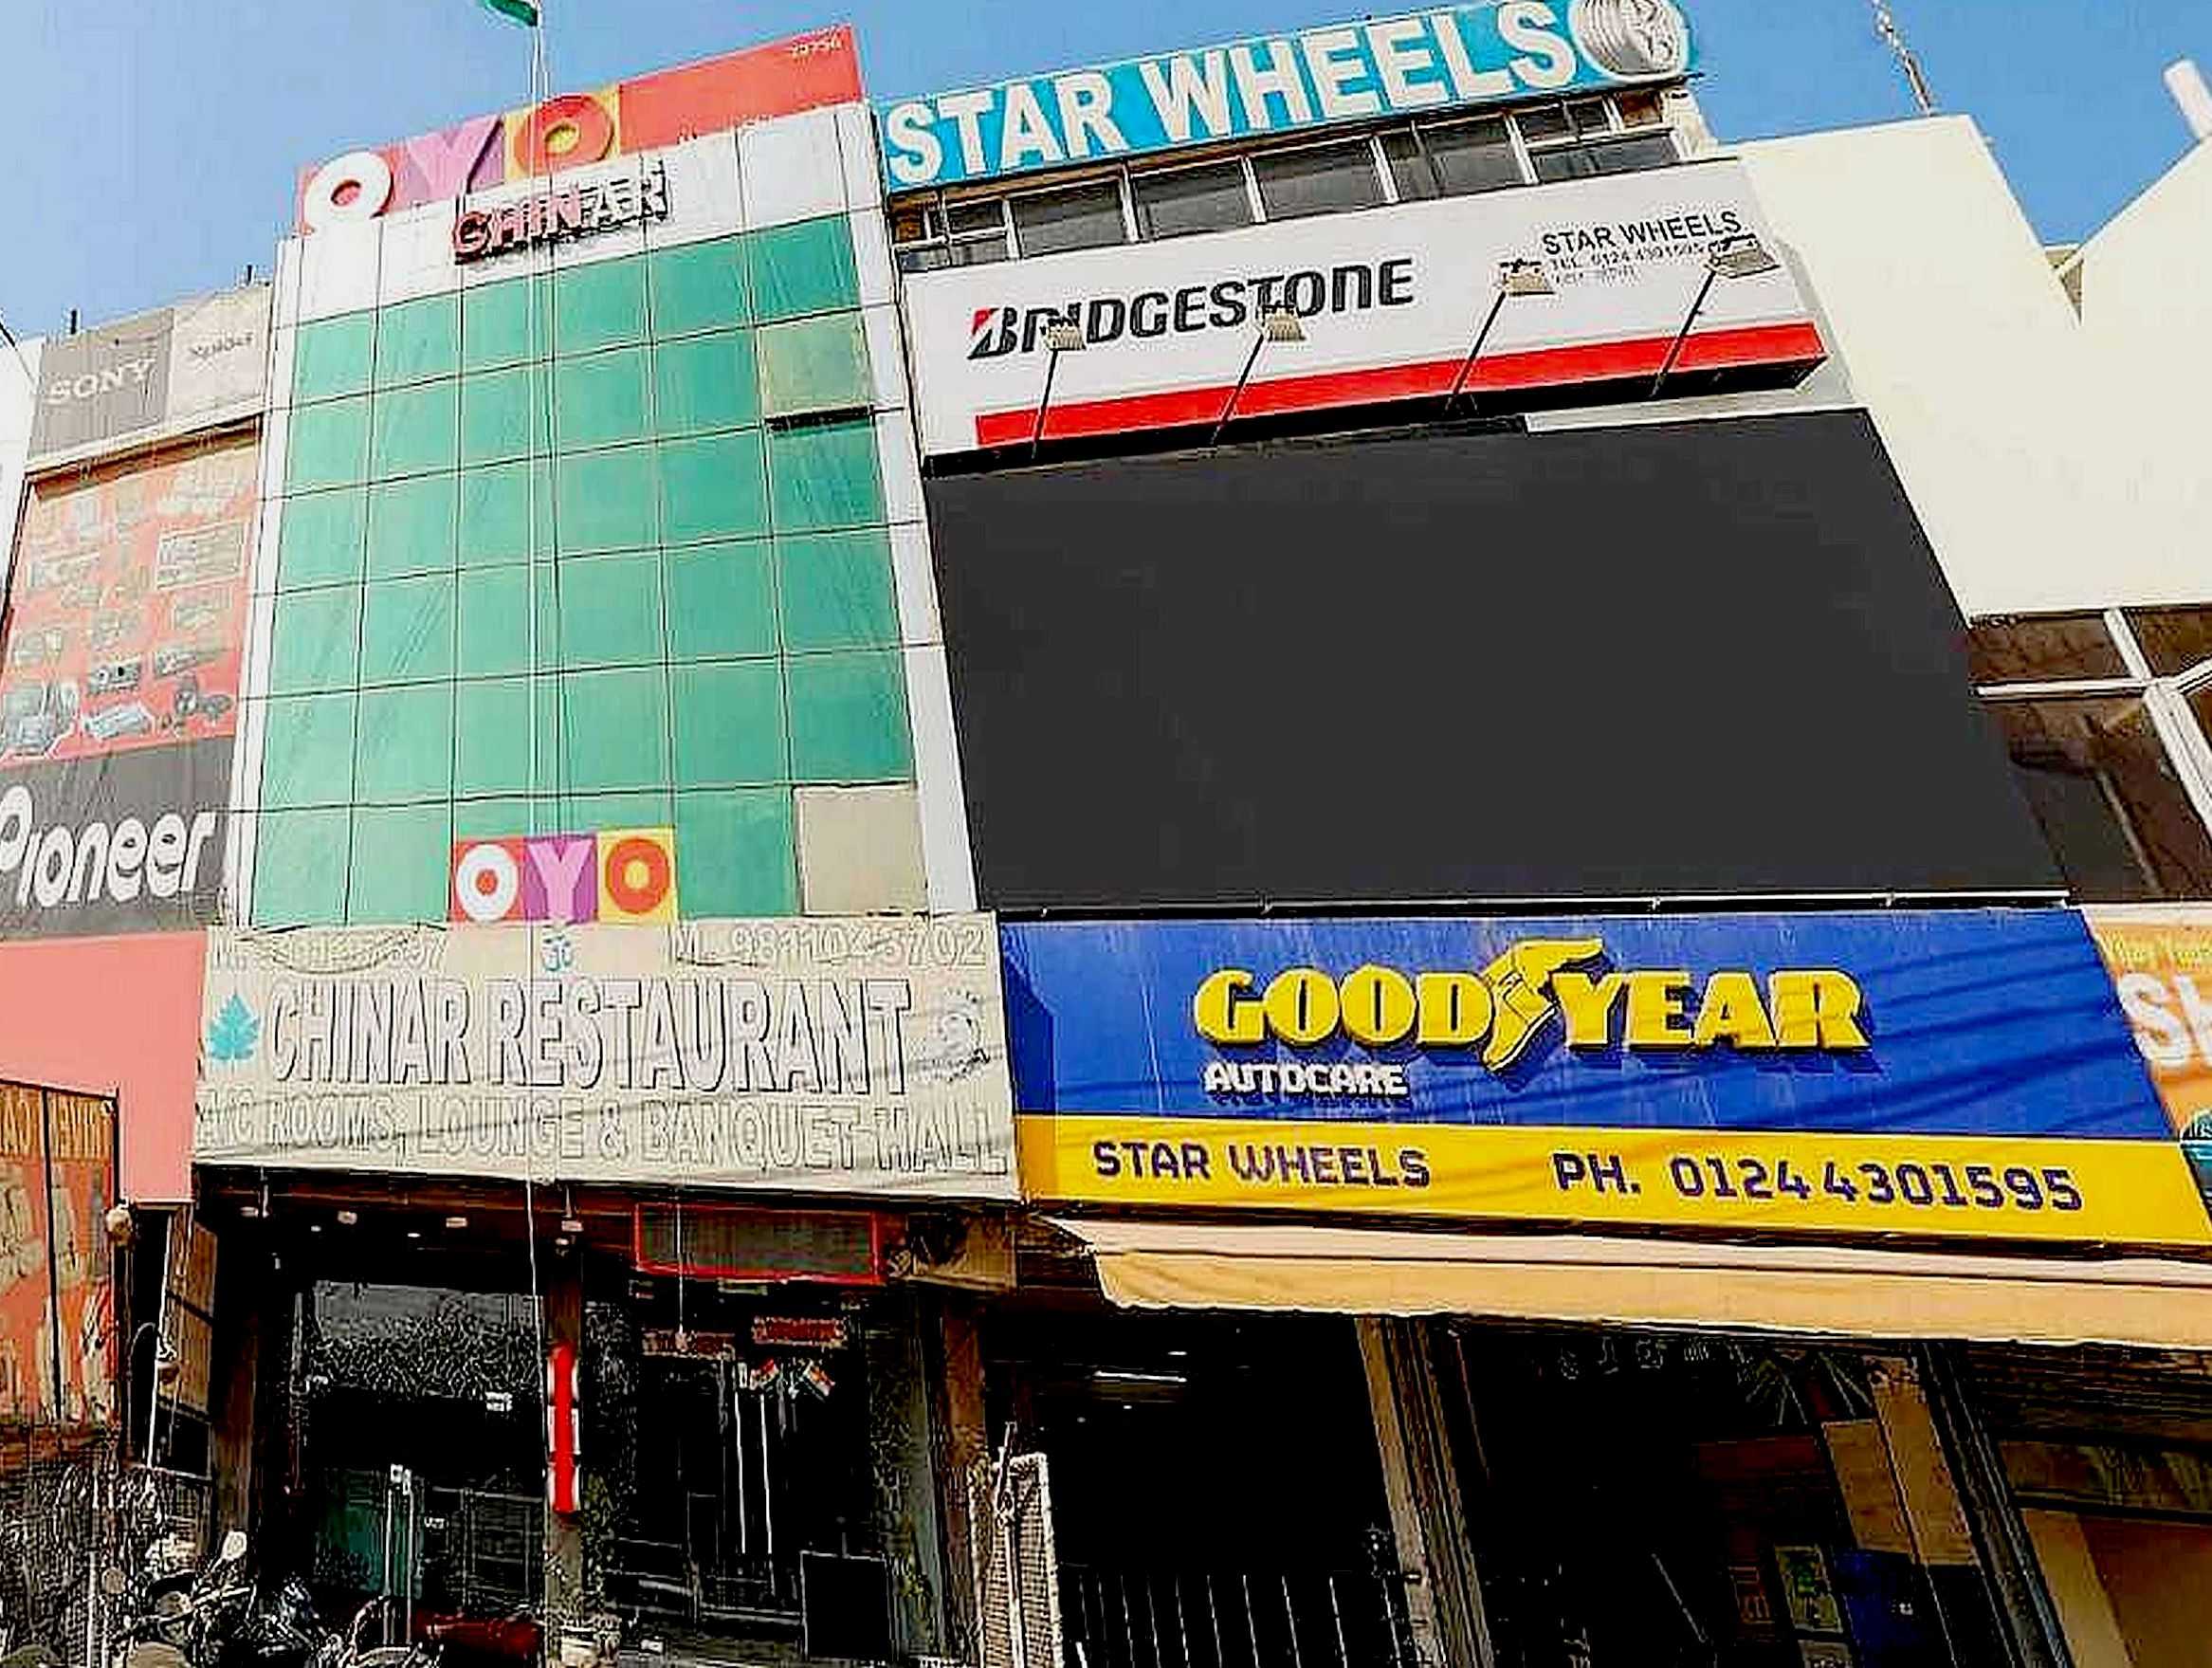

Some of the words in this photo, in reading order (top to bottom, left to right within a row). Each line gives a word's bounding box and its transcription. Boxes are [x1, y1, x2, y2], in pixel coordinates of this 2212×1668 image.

[883, 70, 1128, 184] STAR
[1140, 4, 1578, 143] WHEELS
[303, 92, 616, 229] OYO
[1543, 226, 1617, 255] STAR
[1618, 211, 1743, 245] WHEELS
[967, 258, 1415, 360] BRIDGESTONE
[47, 351, 157, 406] SONY
[0, 785, 218, 908] Pioneer
[455, 834, 674, 929] OYO
[271, 978, 471, 1086] CHINAR
[488, 980, 912, 1095] RESTAURANT
[1203, 1061, 1410, 1097] AUTOCARE
[414, 1093, 586, 1159] LOUNGE
[598, 1099, 626, 1161] &
[1093, 1140, 1211, 1183] STAR
[1228, 1144, 1431, 1189] WHEELS
[1552, 1151, 1642, 1195] PH.
